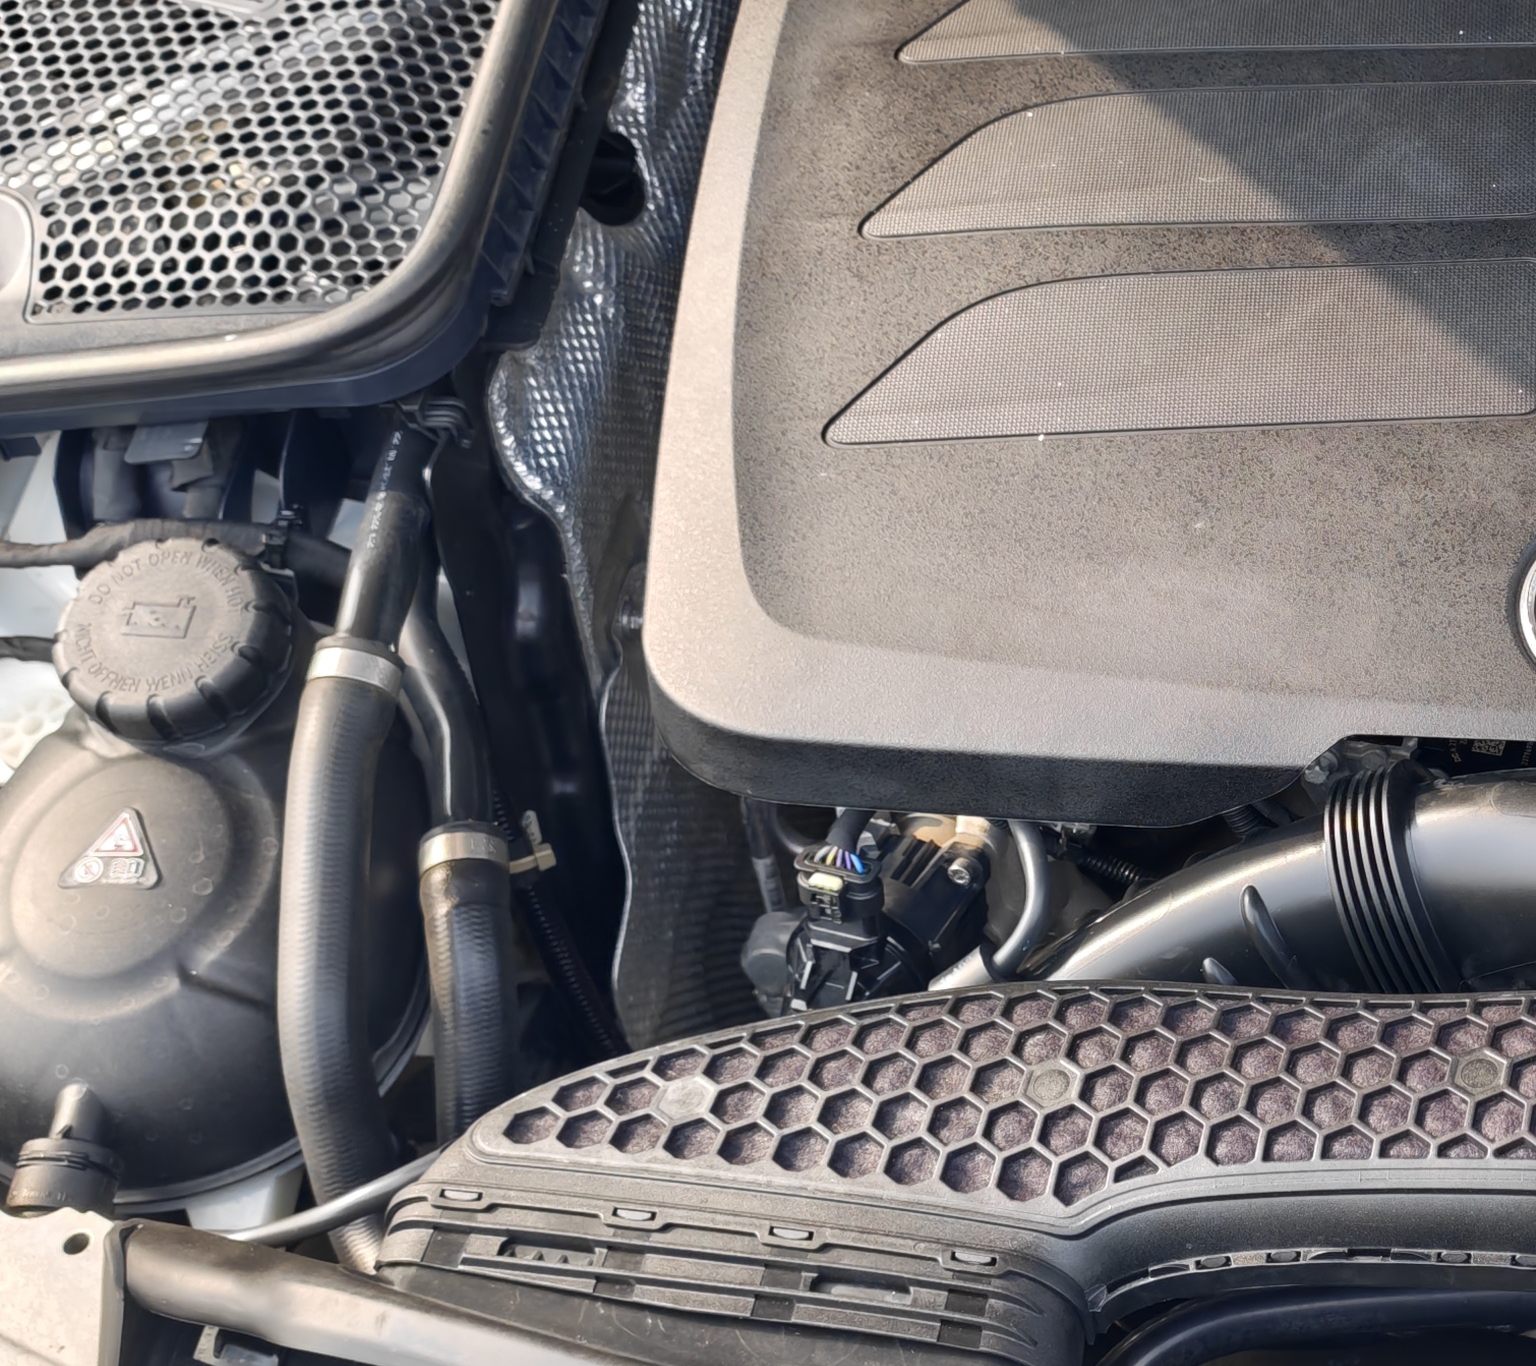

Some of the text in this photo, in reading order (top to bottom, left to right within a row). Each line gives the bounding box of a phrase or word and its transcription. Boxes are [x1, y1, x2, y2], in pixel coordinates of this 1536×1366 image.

[111, 559, 142, 585] NOT
[148, 551, 192, 566] OPEN
[196, 555, 235, 591] WHEN
[146, 667, 192, 690] WENN
